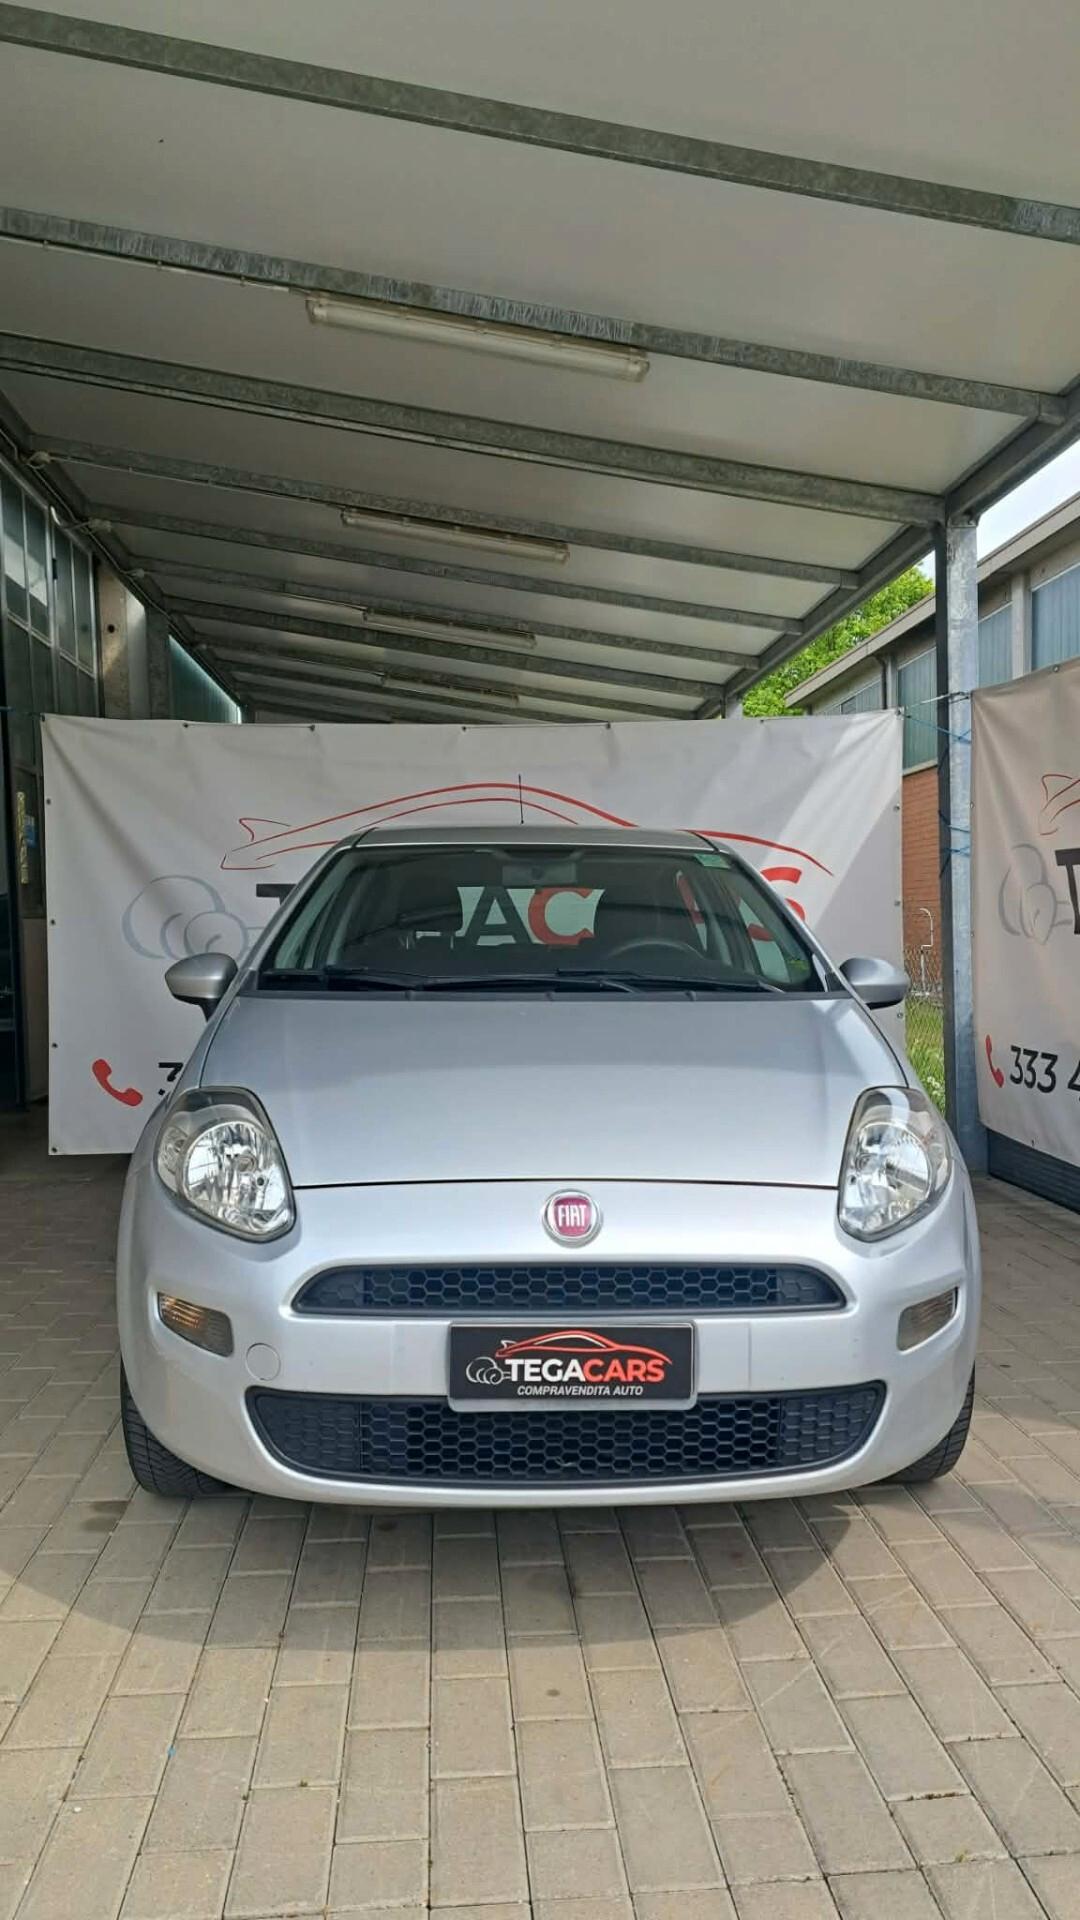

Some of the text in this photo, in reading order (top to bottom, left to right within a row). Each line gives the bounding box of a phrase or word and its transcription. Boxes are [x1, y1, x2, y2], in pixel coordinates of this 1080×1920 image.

[1009, 1045, 1059, 1094] 333
[557, 1204, 587, 1228] FIAT
[504, 1358, 666, 1383] TEGACARS
[517, 1385, 644, 1396] COMPRAVENDITA AUTO
